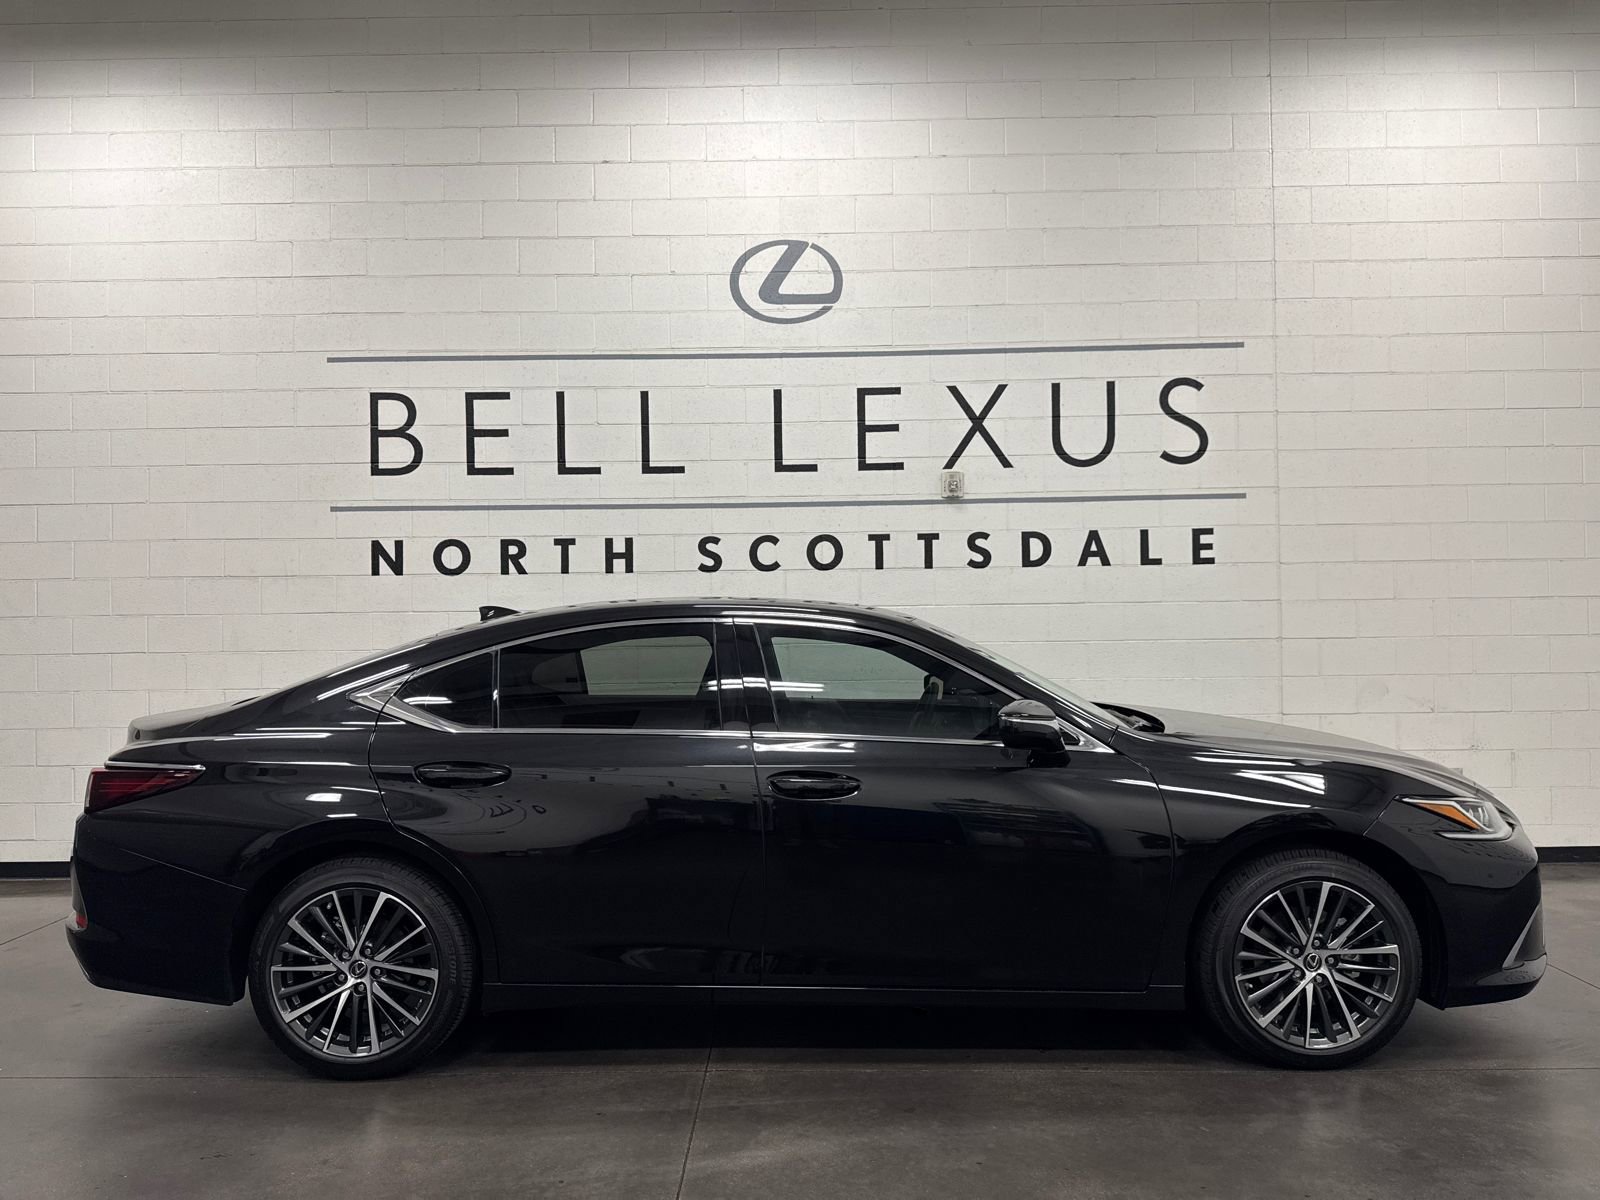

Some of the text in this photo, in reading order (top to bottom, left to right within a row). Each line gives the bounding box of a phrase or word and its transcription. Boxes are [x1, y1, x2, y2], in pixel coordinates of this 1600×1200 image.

[370, 378, 1208, 476] BELL LEXUS
[371, 528, 1215, 576] NORTH SCOTTSDALE
